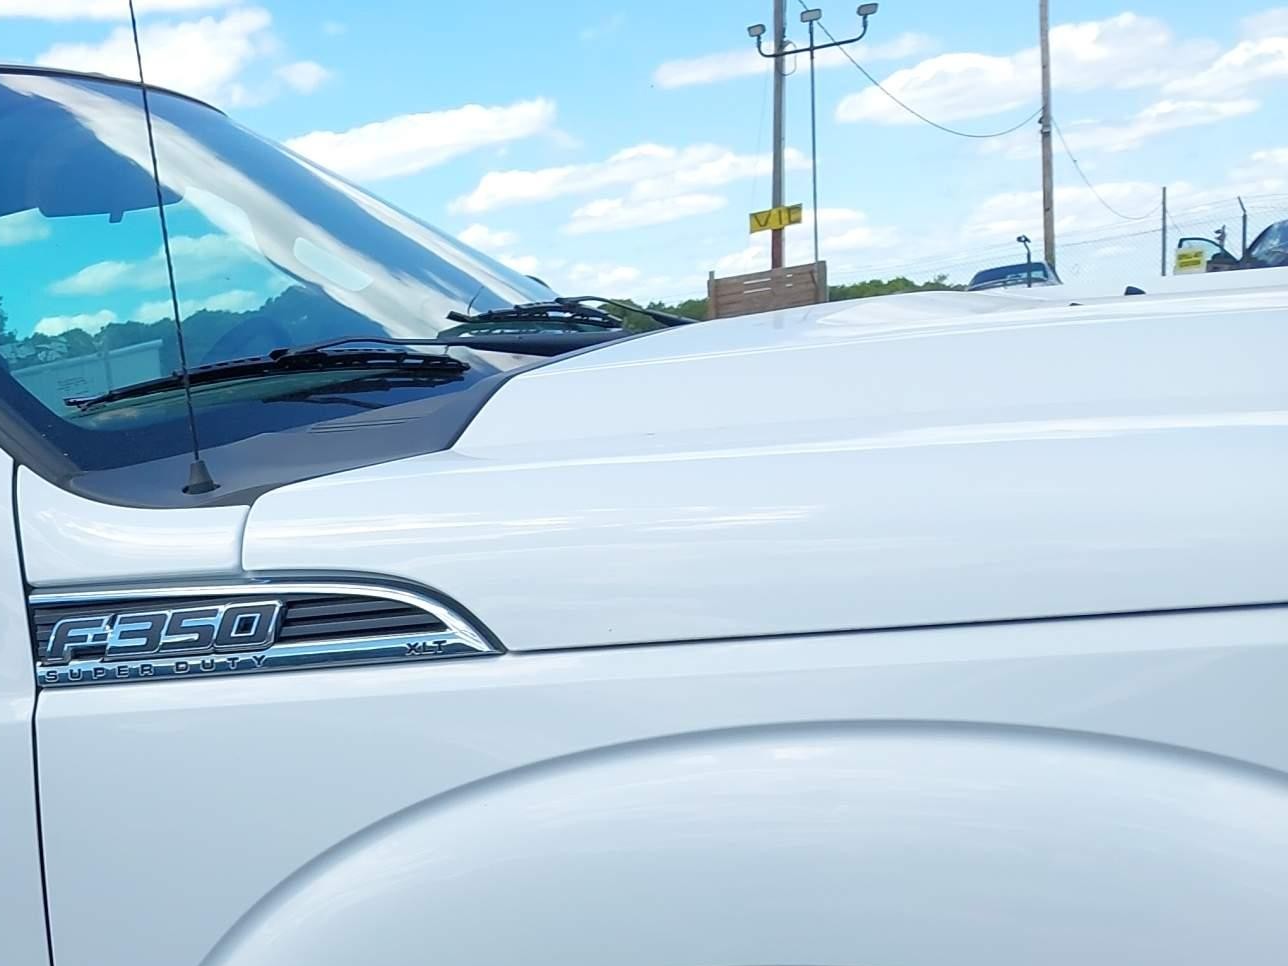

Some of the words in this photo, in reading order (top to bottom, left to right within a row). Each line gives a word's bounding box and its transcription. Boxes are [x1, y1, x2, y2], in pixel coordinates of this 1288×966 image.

[406, 640, 447, 655] XLT
[45, 664, 155, 682] SUPER
[174, 654, 267, 674] DUTY
